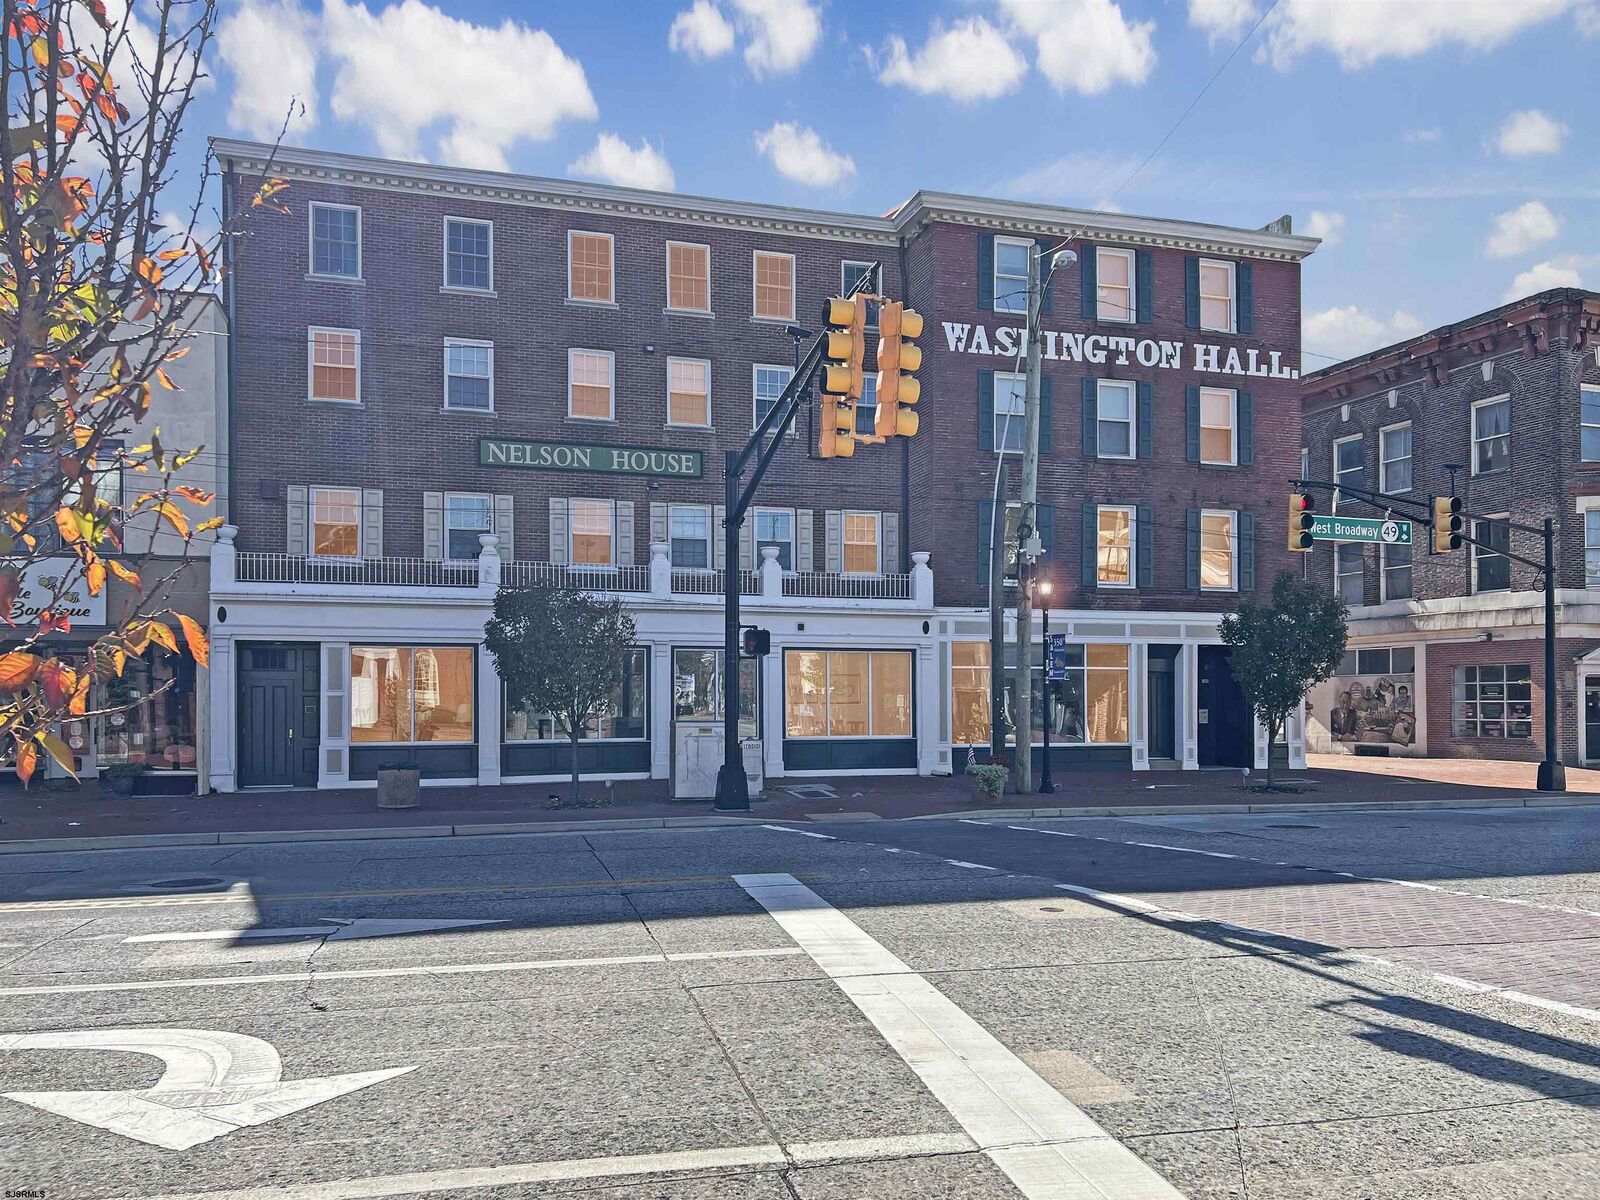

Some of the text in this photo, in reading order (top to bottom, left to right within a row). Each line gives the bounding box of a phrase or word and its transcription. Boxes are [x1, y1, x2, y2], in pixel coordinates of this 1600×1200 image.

[487, 442, 694, 474] NELSON HOUSE
[1335, 522, 1379, 539] Broadway
[1383, 526, 1397, 538] 49
